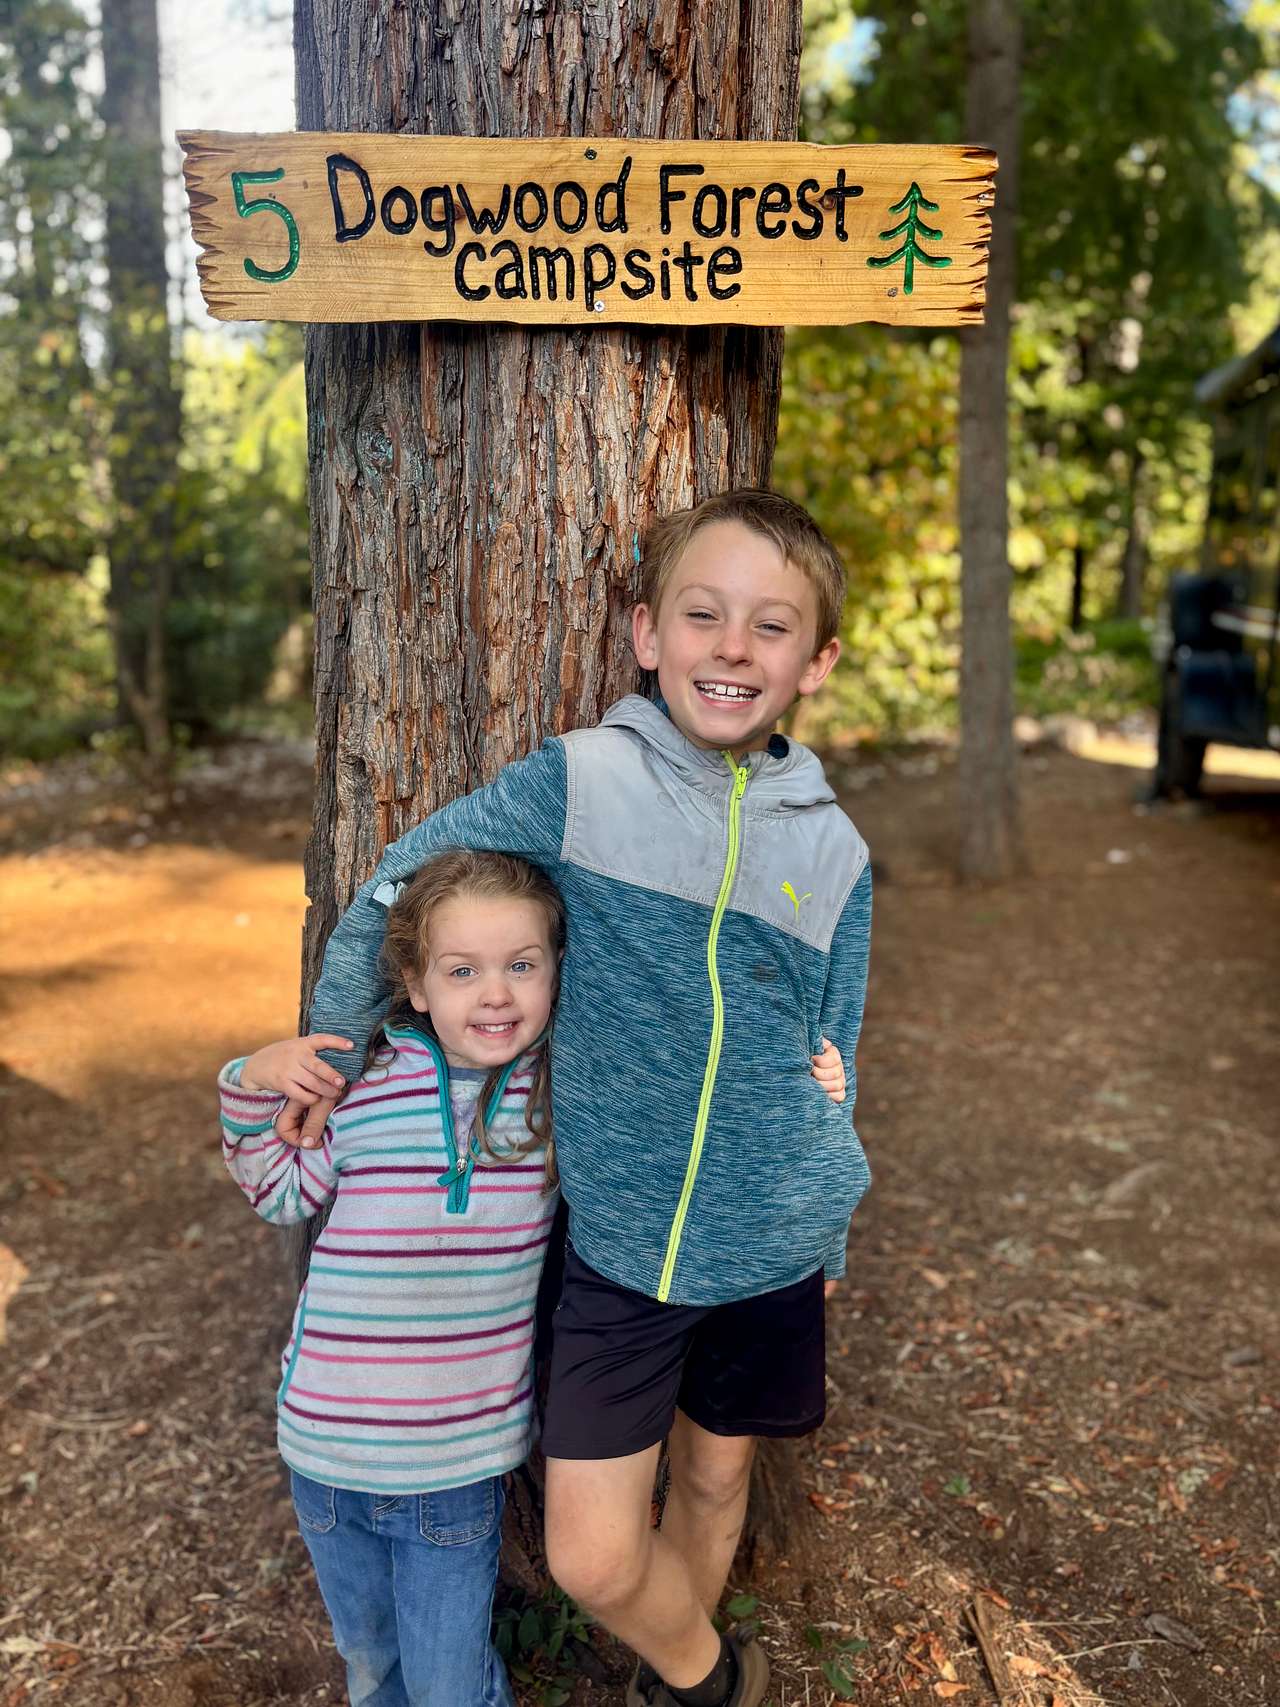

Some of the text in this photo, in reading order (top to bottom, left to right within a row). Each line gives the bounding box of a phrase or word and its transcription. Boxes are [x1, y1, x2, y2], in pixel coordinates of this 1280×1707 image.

[231, 167, 300, 284] 5
[325, 152, 864, 258] Dogwood Forest
